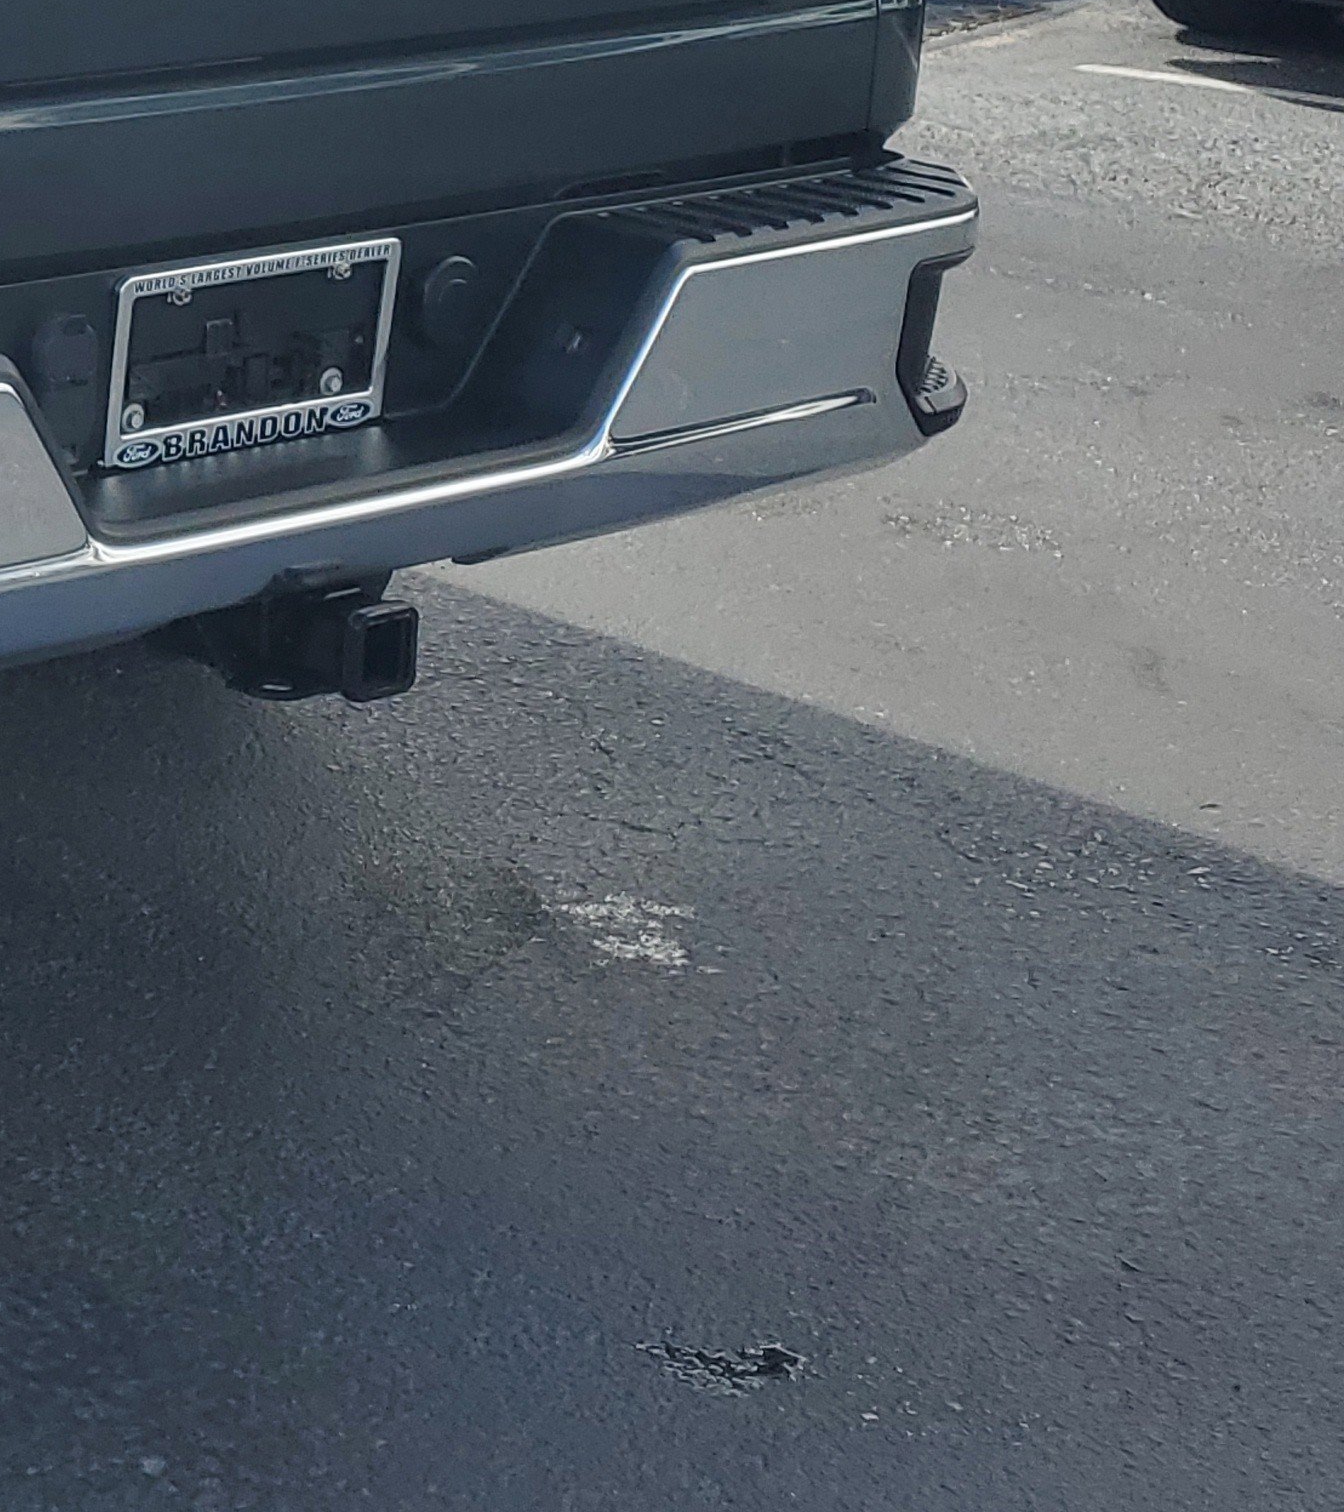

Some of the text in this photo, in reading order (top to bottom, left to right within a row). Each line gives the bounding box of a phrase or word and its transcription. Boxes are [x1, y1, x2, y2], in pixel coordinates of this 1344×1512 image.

[192, 266, 241, 284] LARGEST
[246, 258, 291, 276] VOLUME
[122, 401, 365, 463] Ford BRANDON Ford
